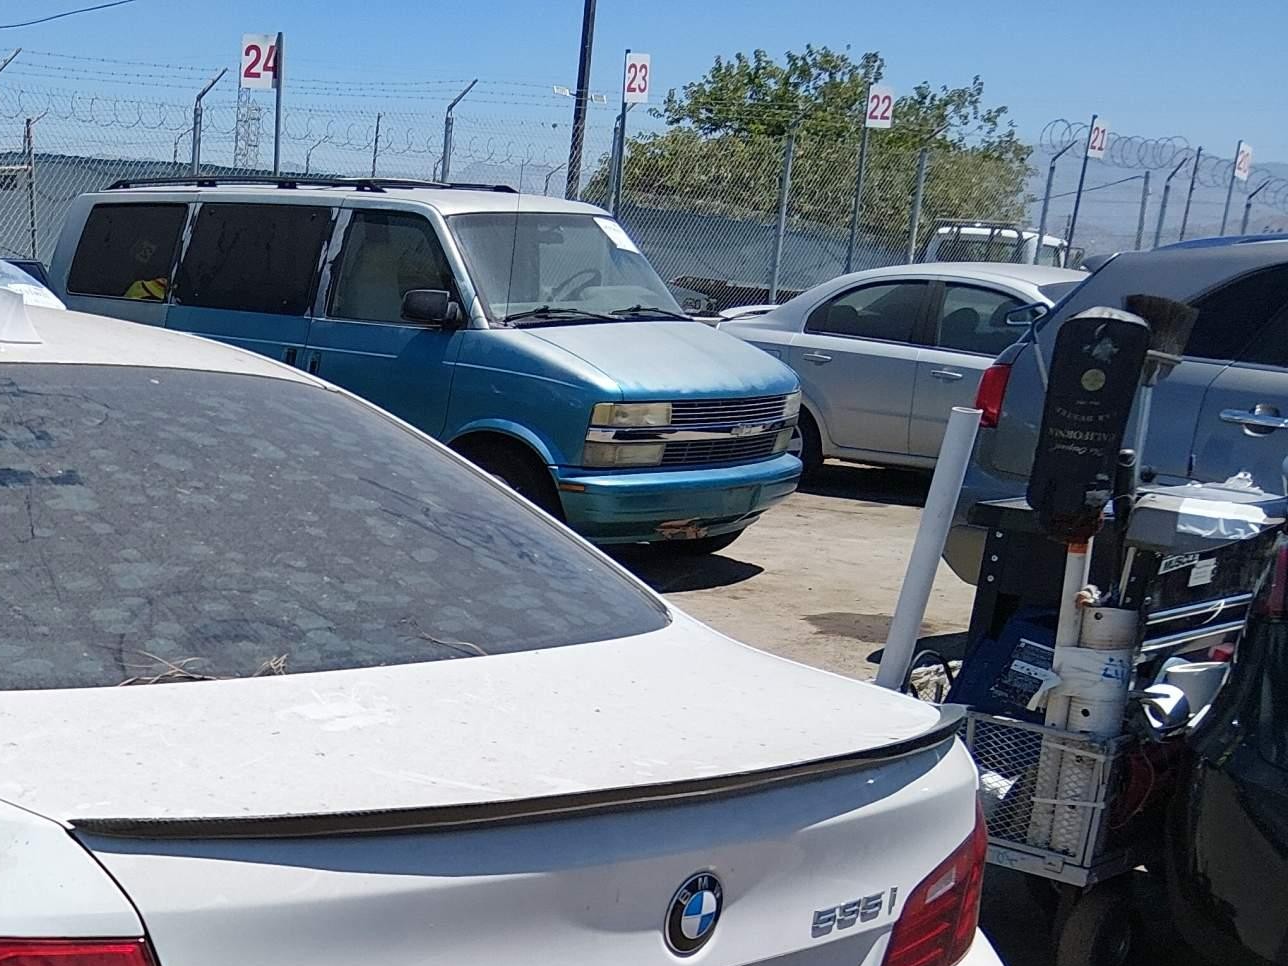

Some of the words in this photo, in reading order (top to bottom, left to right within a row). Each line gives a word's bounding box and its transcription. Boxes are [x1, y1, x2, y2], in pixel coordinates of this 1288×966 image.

[243, 44, 278, 80] 24
[625, 63, 649, 94] 23
[868, 94, 893, 121] 22
[1090, 126, 1107, 152] 21
[678, 876, 721, 905] BMW
